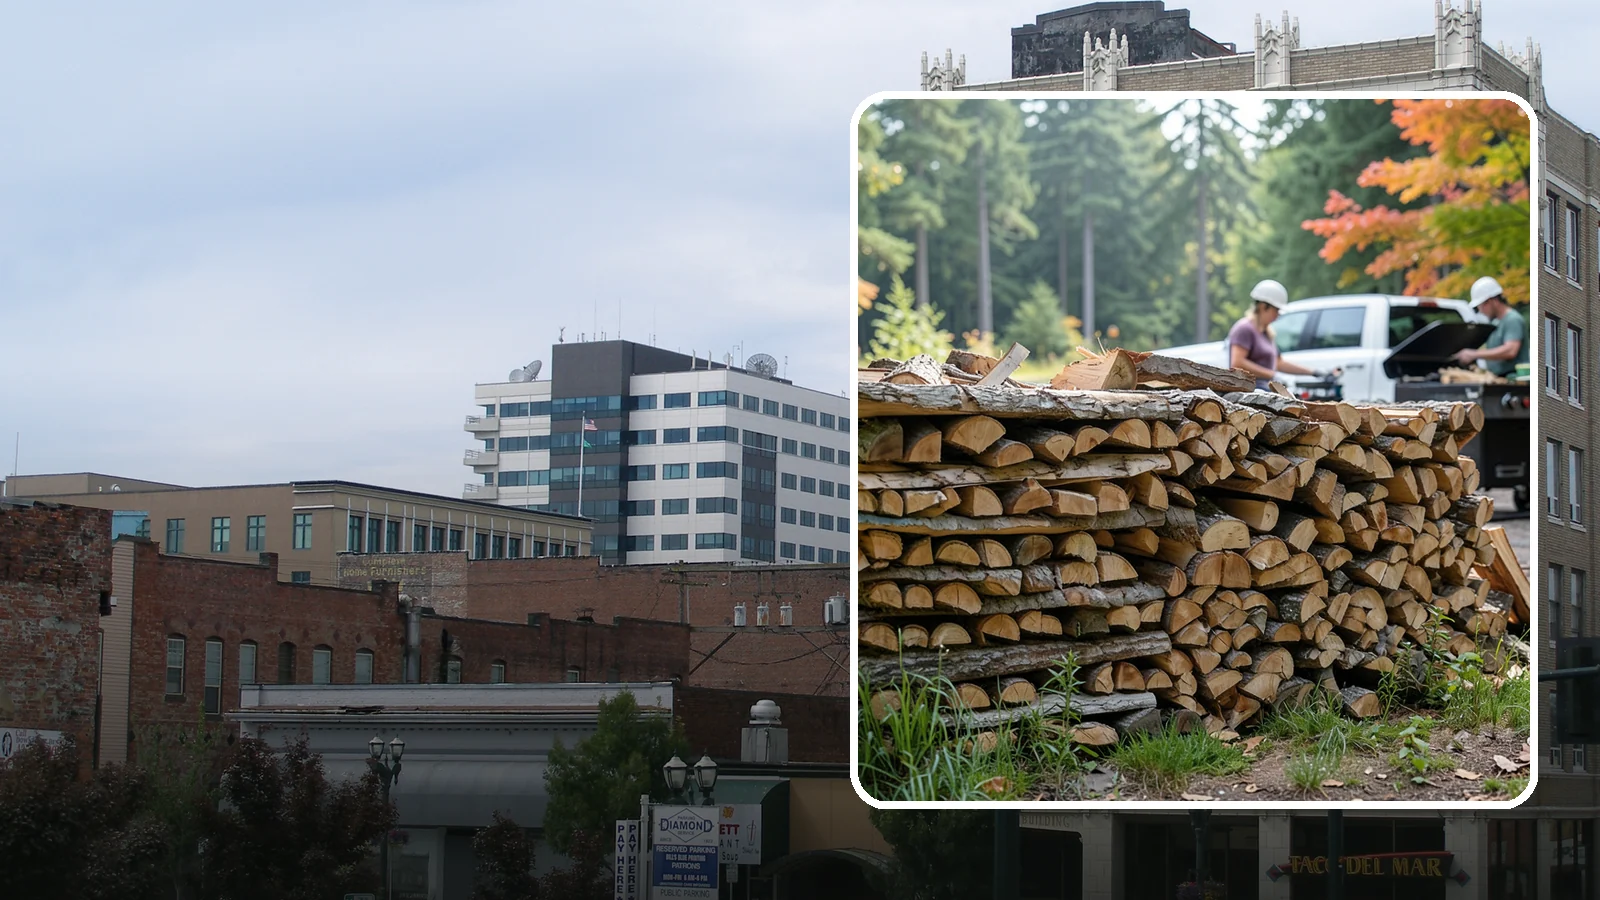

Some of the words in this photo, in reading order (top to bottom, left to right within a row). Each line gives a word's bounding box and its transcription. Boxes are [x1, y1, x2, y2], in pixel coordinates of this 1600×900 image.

[343, 567, 367, 577] Home
[371, 566, 427, 576] Furnishers
[660, 818, 713, 832] DIAMOND
[1022, 815, 1069, 827] BUILDING
[617, 825, 625, 852] PAY
[628, 825, 637, 852] PAY
[722, 852, 738, 862] Soup
[616, 856, 625, 893] HERE
[627, 856, 636, 893] HERE
[1290, 856, 1329, 874] TAC
[1346, 856, 1384, 875] DEL
[1392, 857, 1443, 876] MAR
[684, 890, 710, 898] PARKING
